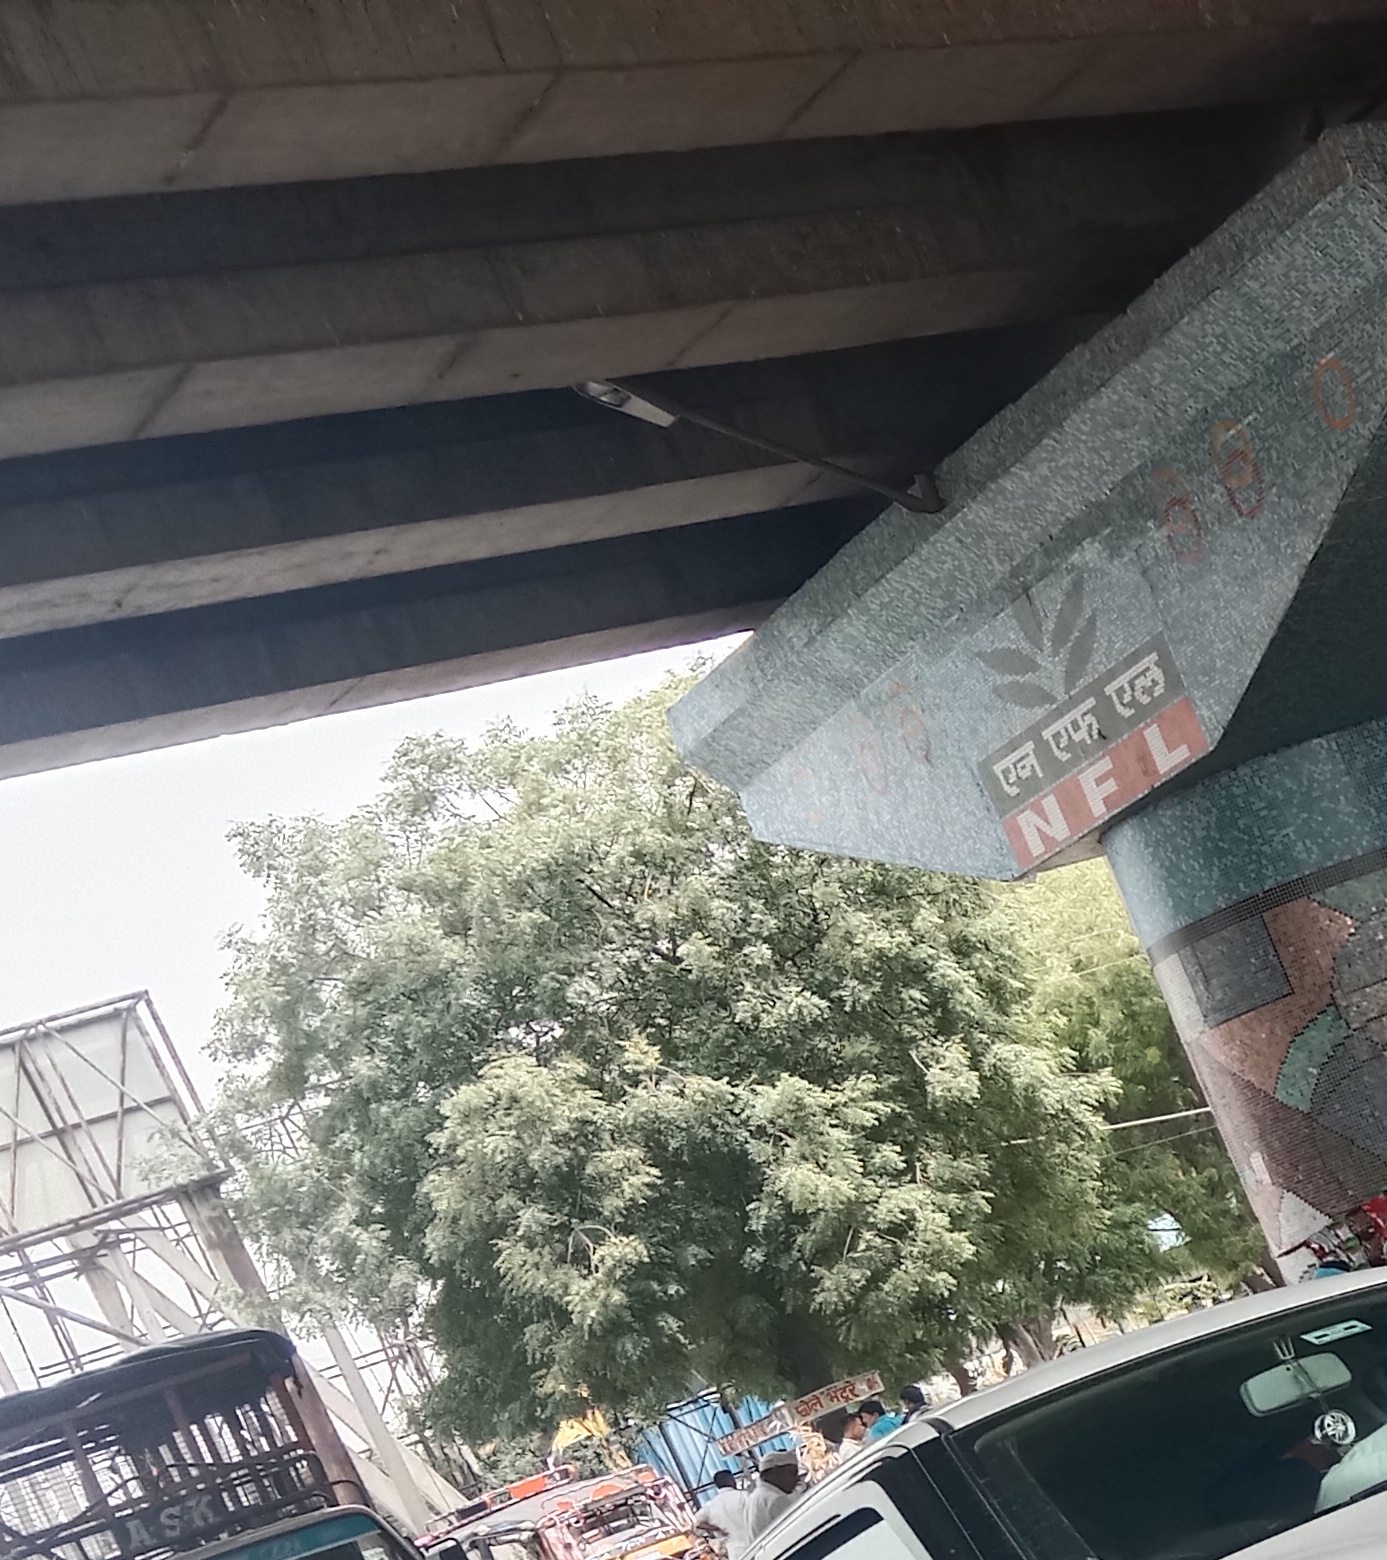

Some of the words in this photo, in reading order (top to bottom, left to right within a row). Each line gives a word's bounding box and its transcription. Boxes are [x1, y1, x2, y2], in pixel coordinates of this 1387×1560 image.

[992, 741, 1044, 797] एन
[1041, 696, 1101, 762] एफ
[1104, 651, 1166, 718] एल
